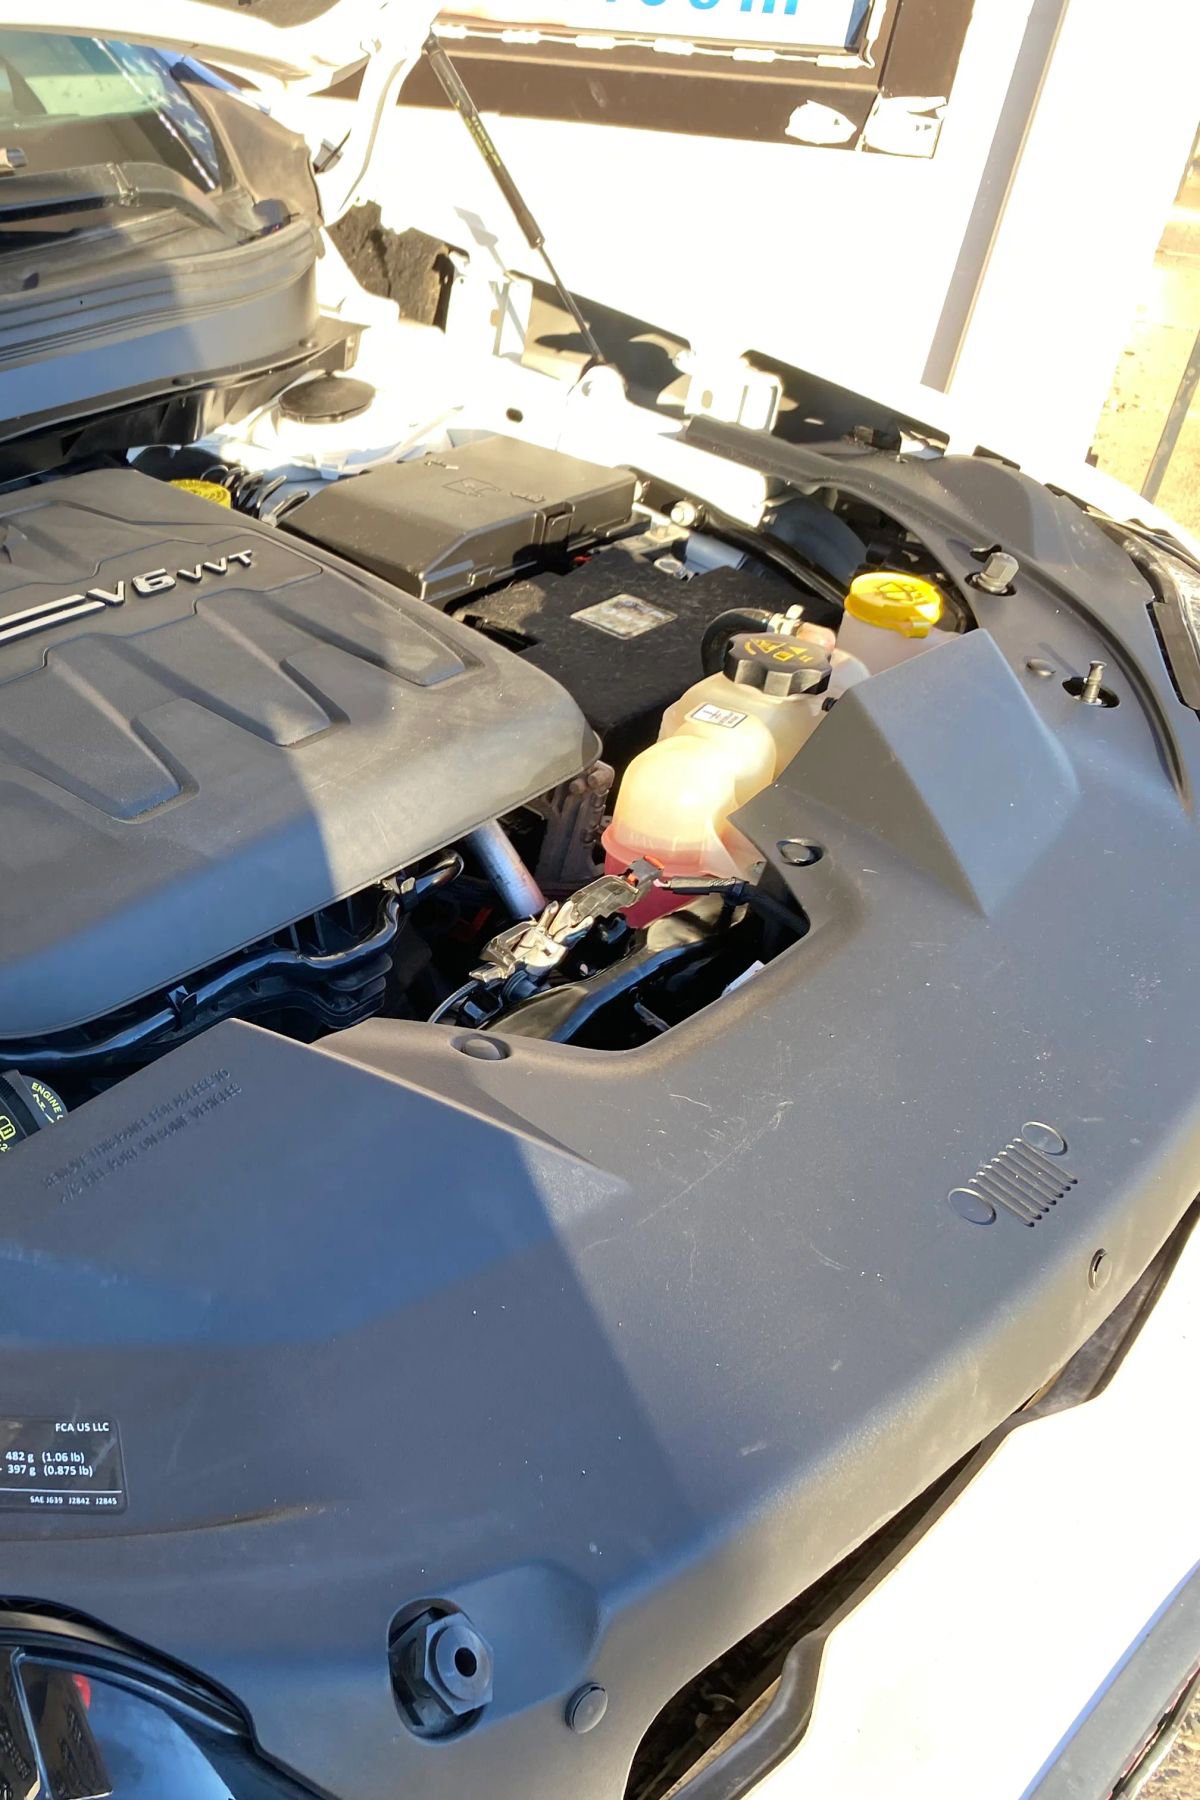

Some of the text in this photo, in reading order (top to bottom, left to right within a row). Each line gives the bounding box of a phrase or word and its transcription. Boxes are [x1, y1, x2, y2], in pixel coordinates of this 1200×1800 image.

[87, 549, 253, 606] V6 VVT
[31, 1082, 62, 1113] ENGINE
[55, 1422, 110, 1432] FCA US LLC
[5, 1451, 25, 1461] 482
[27, 1453, 34, 1463] g
[41, 1452, 68, 1464] (1.06
[70, 1452, 85, 1464] lb)
[7, 1464, 27, 1474] 397
[29, 1466, 36, 1477] g
[43, 1465, 76, 1477] (0.875
[78, 1465, 93, 1478] lb)
[29, 1495, 45, 1504] SAE
[68, 1497, 90, 1505] J2842
[95, 1497, 118, 1505] J2845
